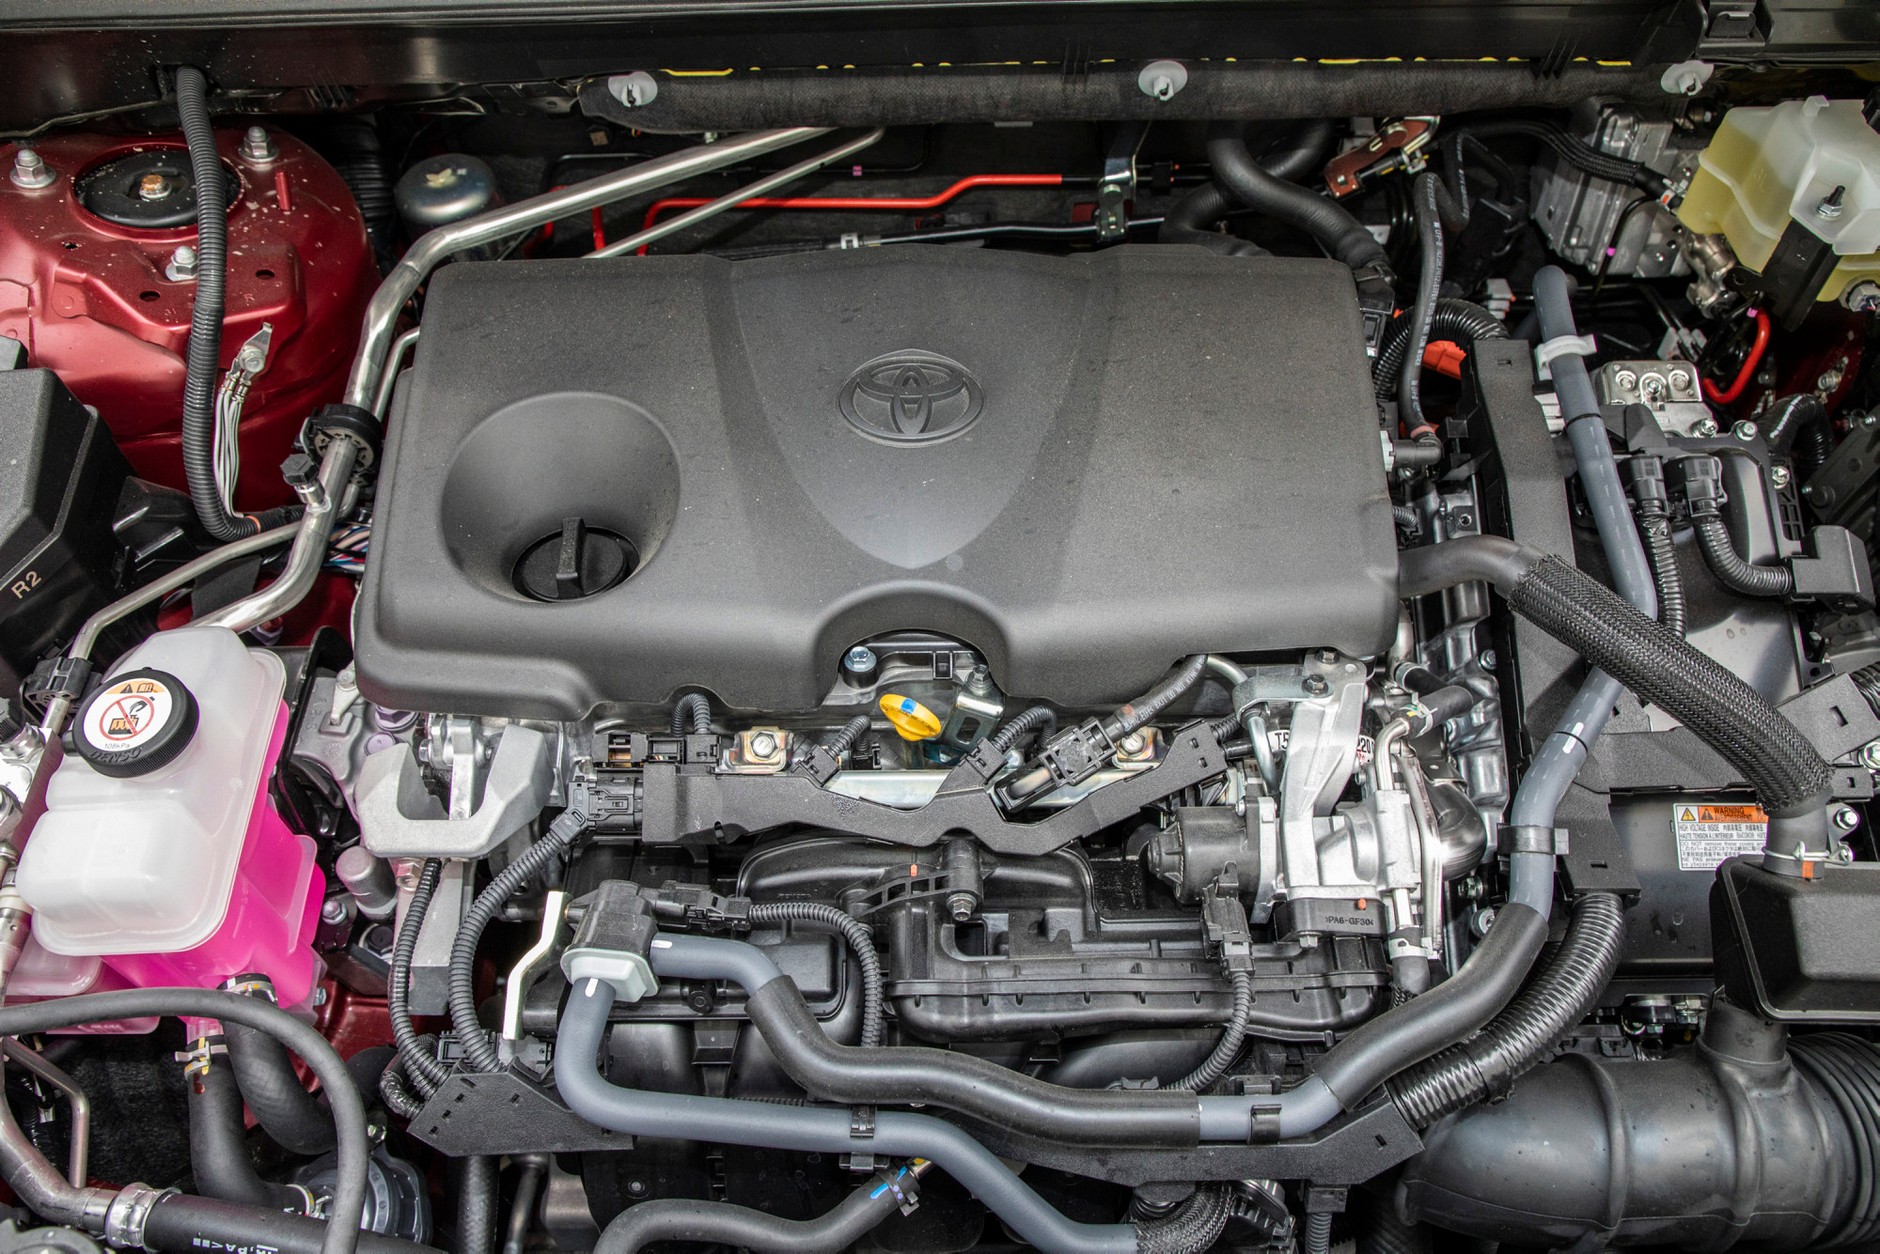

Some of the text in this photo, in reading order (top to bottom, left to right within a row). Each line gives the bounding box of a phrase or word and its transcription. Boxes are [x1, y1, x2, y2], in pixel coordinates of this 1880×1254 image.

[11, 571, 42, 599] R2
[89, 748, 142, 763] DENSO
[1713, 806, 1744, 815] WARNING
